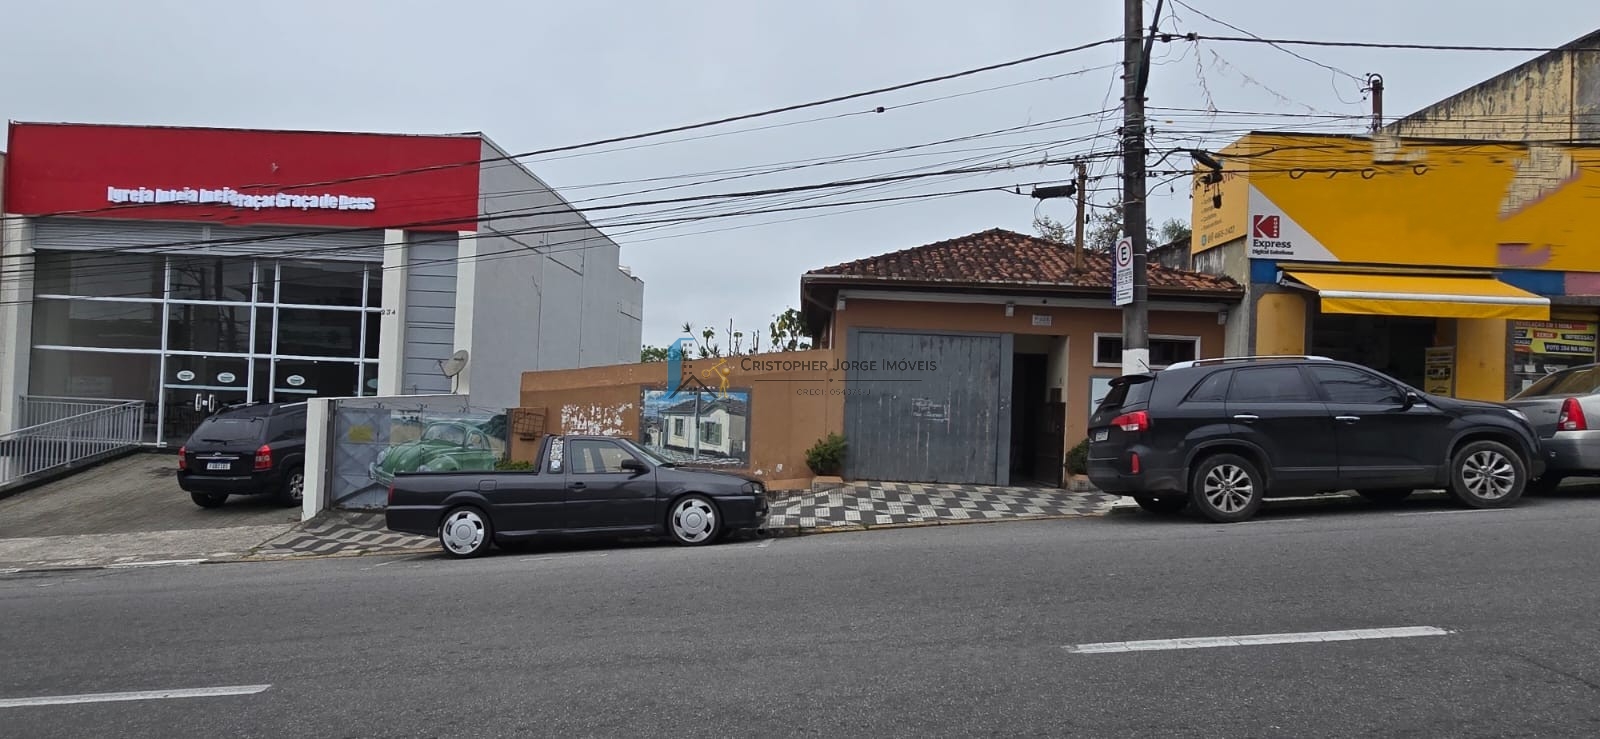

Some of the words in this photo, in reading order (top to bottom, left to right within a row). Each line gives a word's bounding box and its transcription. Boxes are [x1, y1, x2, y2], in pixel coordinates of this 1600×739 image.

[1252, 239, 1292, 249] Express
[1121, 247, 1127, 261] E
[1546, 343, 1560, 351] FOTO
